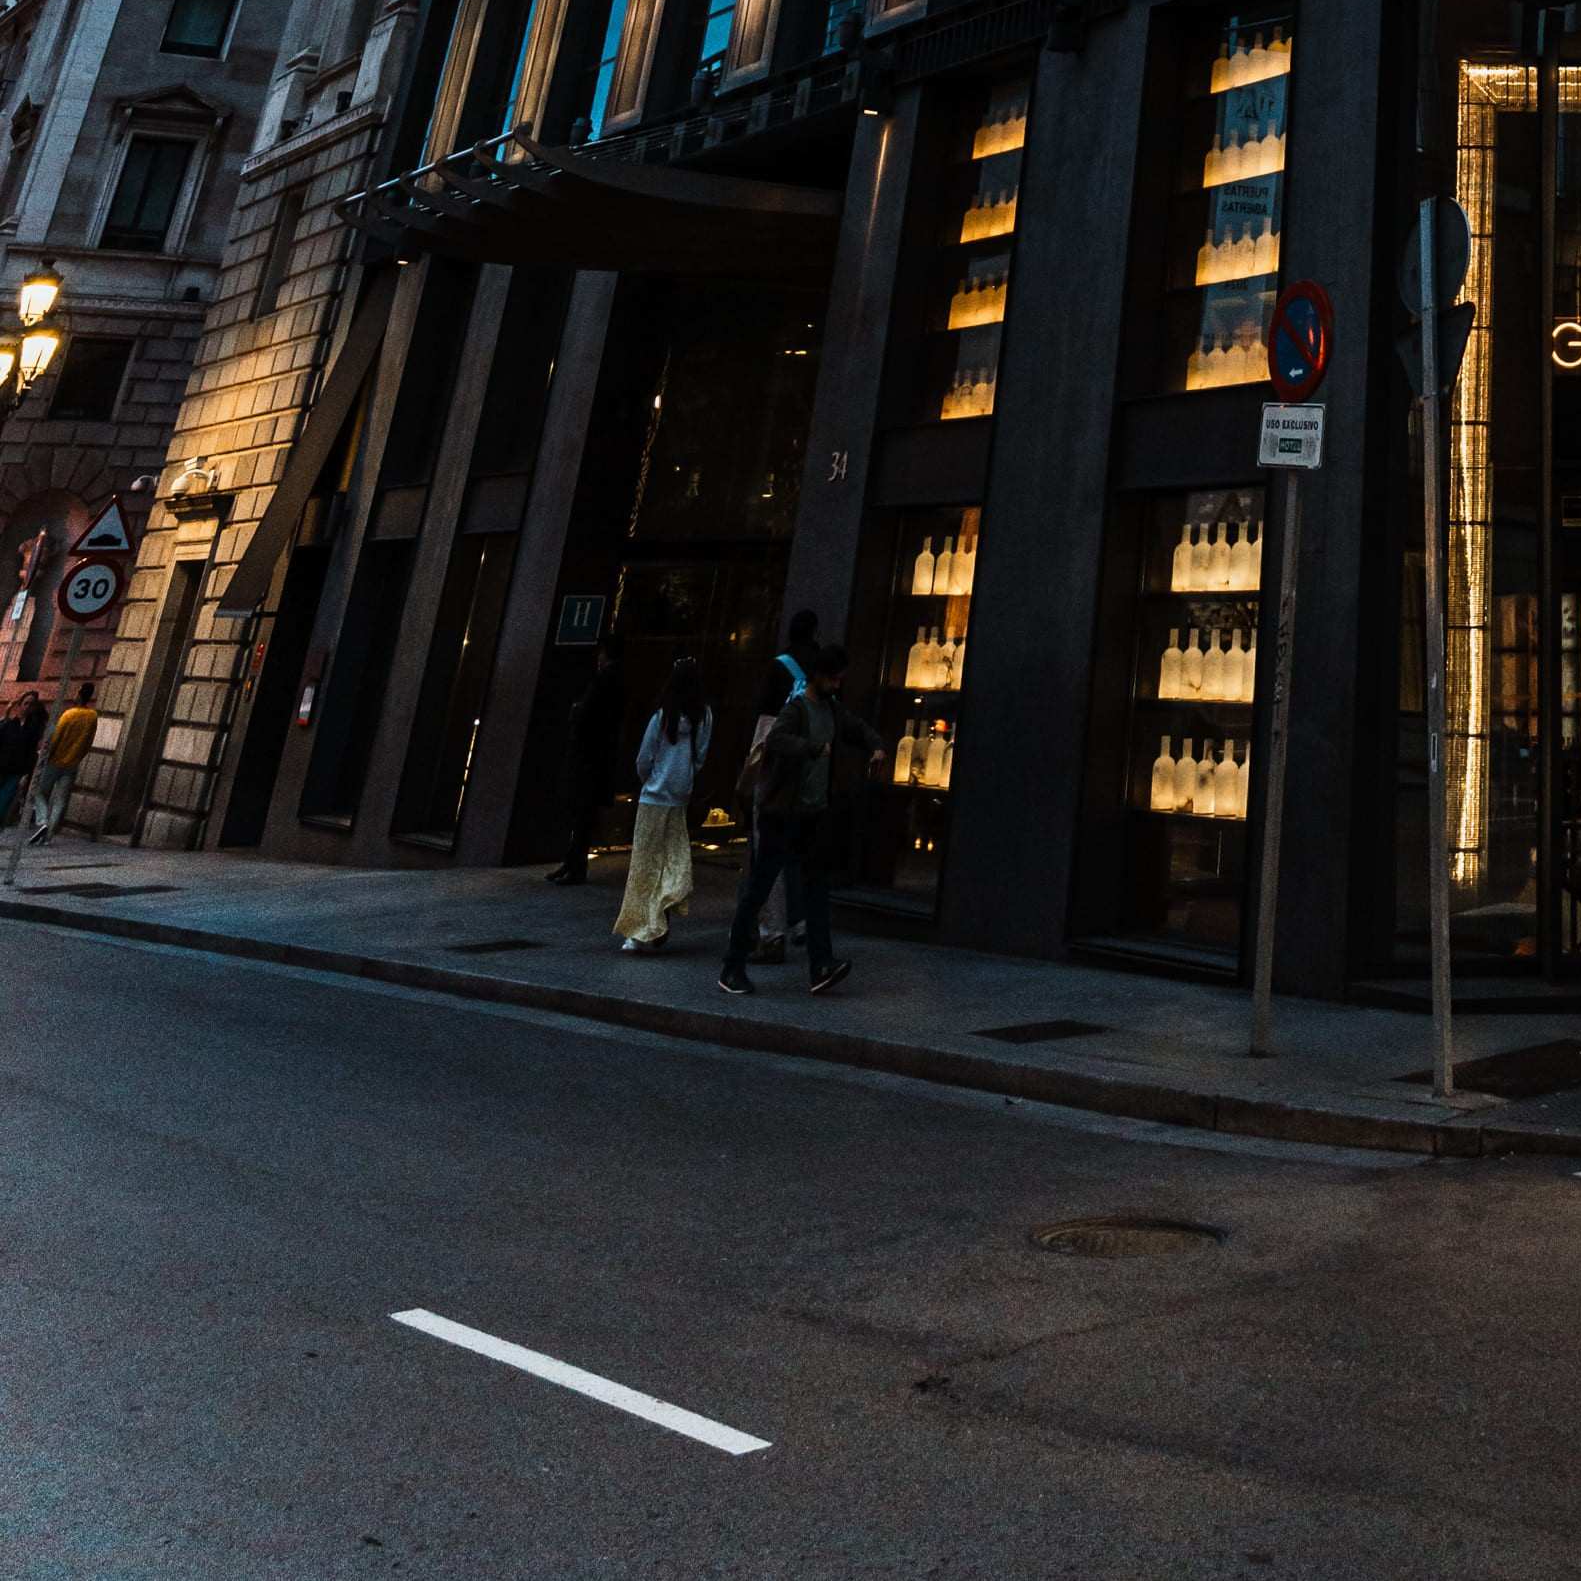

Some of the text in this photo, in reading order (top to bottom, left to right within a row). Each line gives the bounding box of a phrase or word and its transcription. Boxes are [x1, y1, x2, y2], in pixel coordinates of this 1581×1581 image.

[1265, 419, 1319, 431] USO EXCLUSIVO
[828, 450, 848, 481] 34
[73, 578, 109, 599] 30
